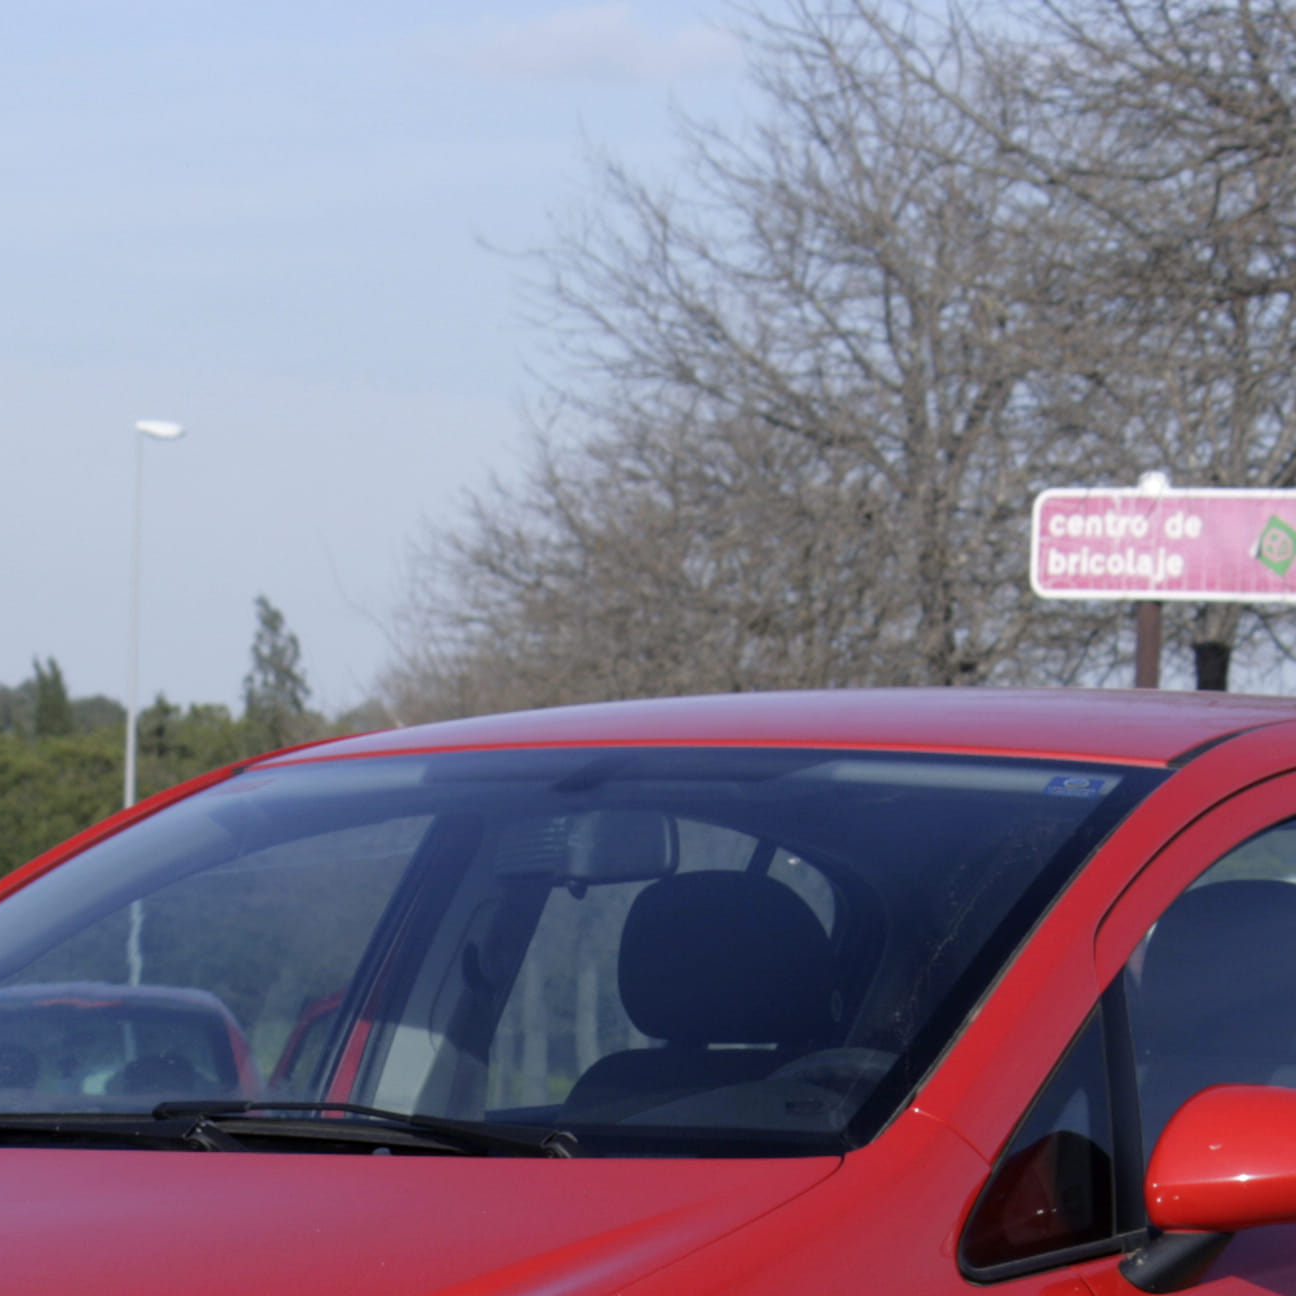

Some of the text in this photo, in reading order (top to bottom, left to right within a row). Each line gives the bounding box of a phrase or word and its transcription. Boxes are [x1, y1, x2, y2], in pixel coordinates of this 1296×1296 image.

[1049, 511, 1203, 539] centro de
[1048, 547, 1184, 582] bricolaje
